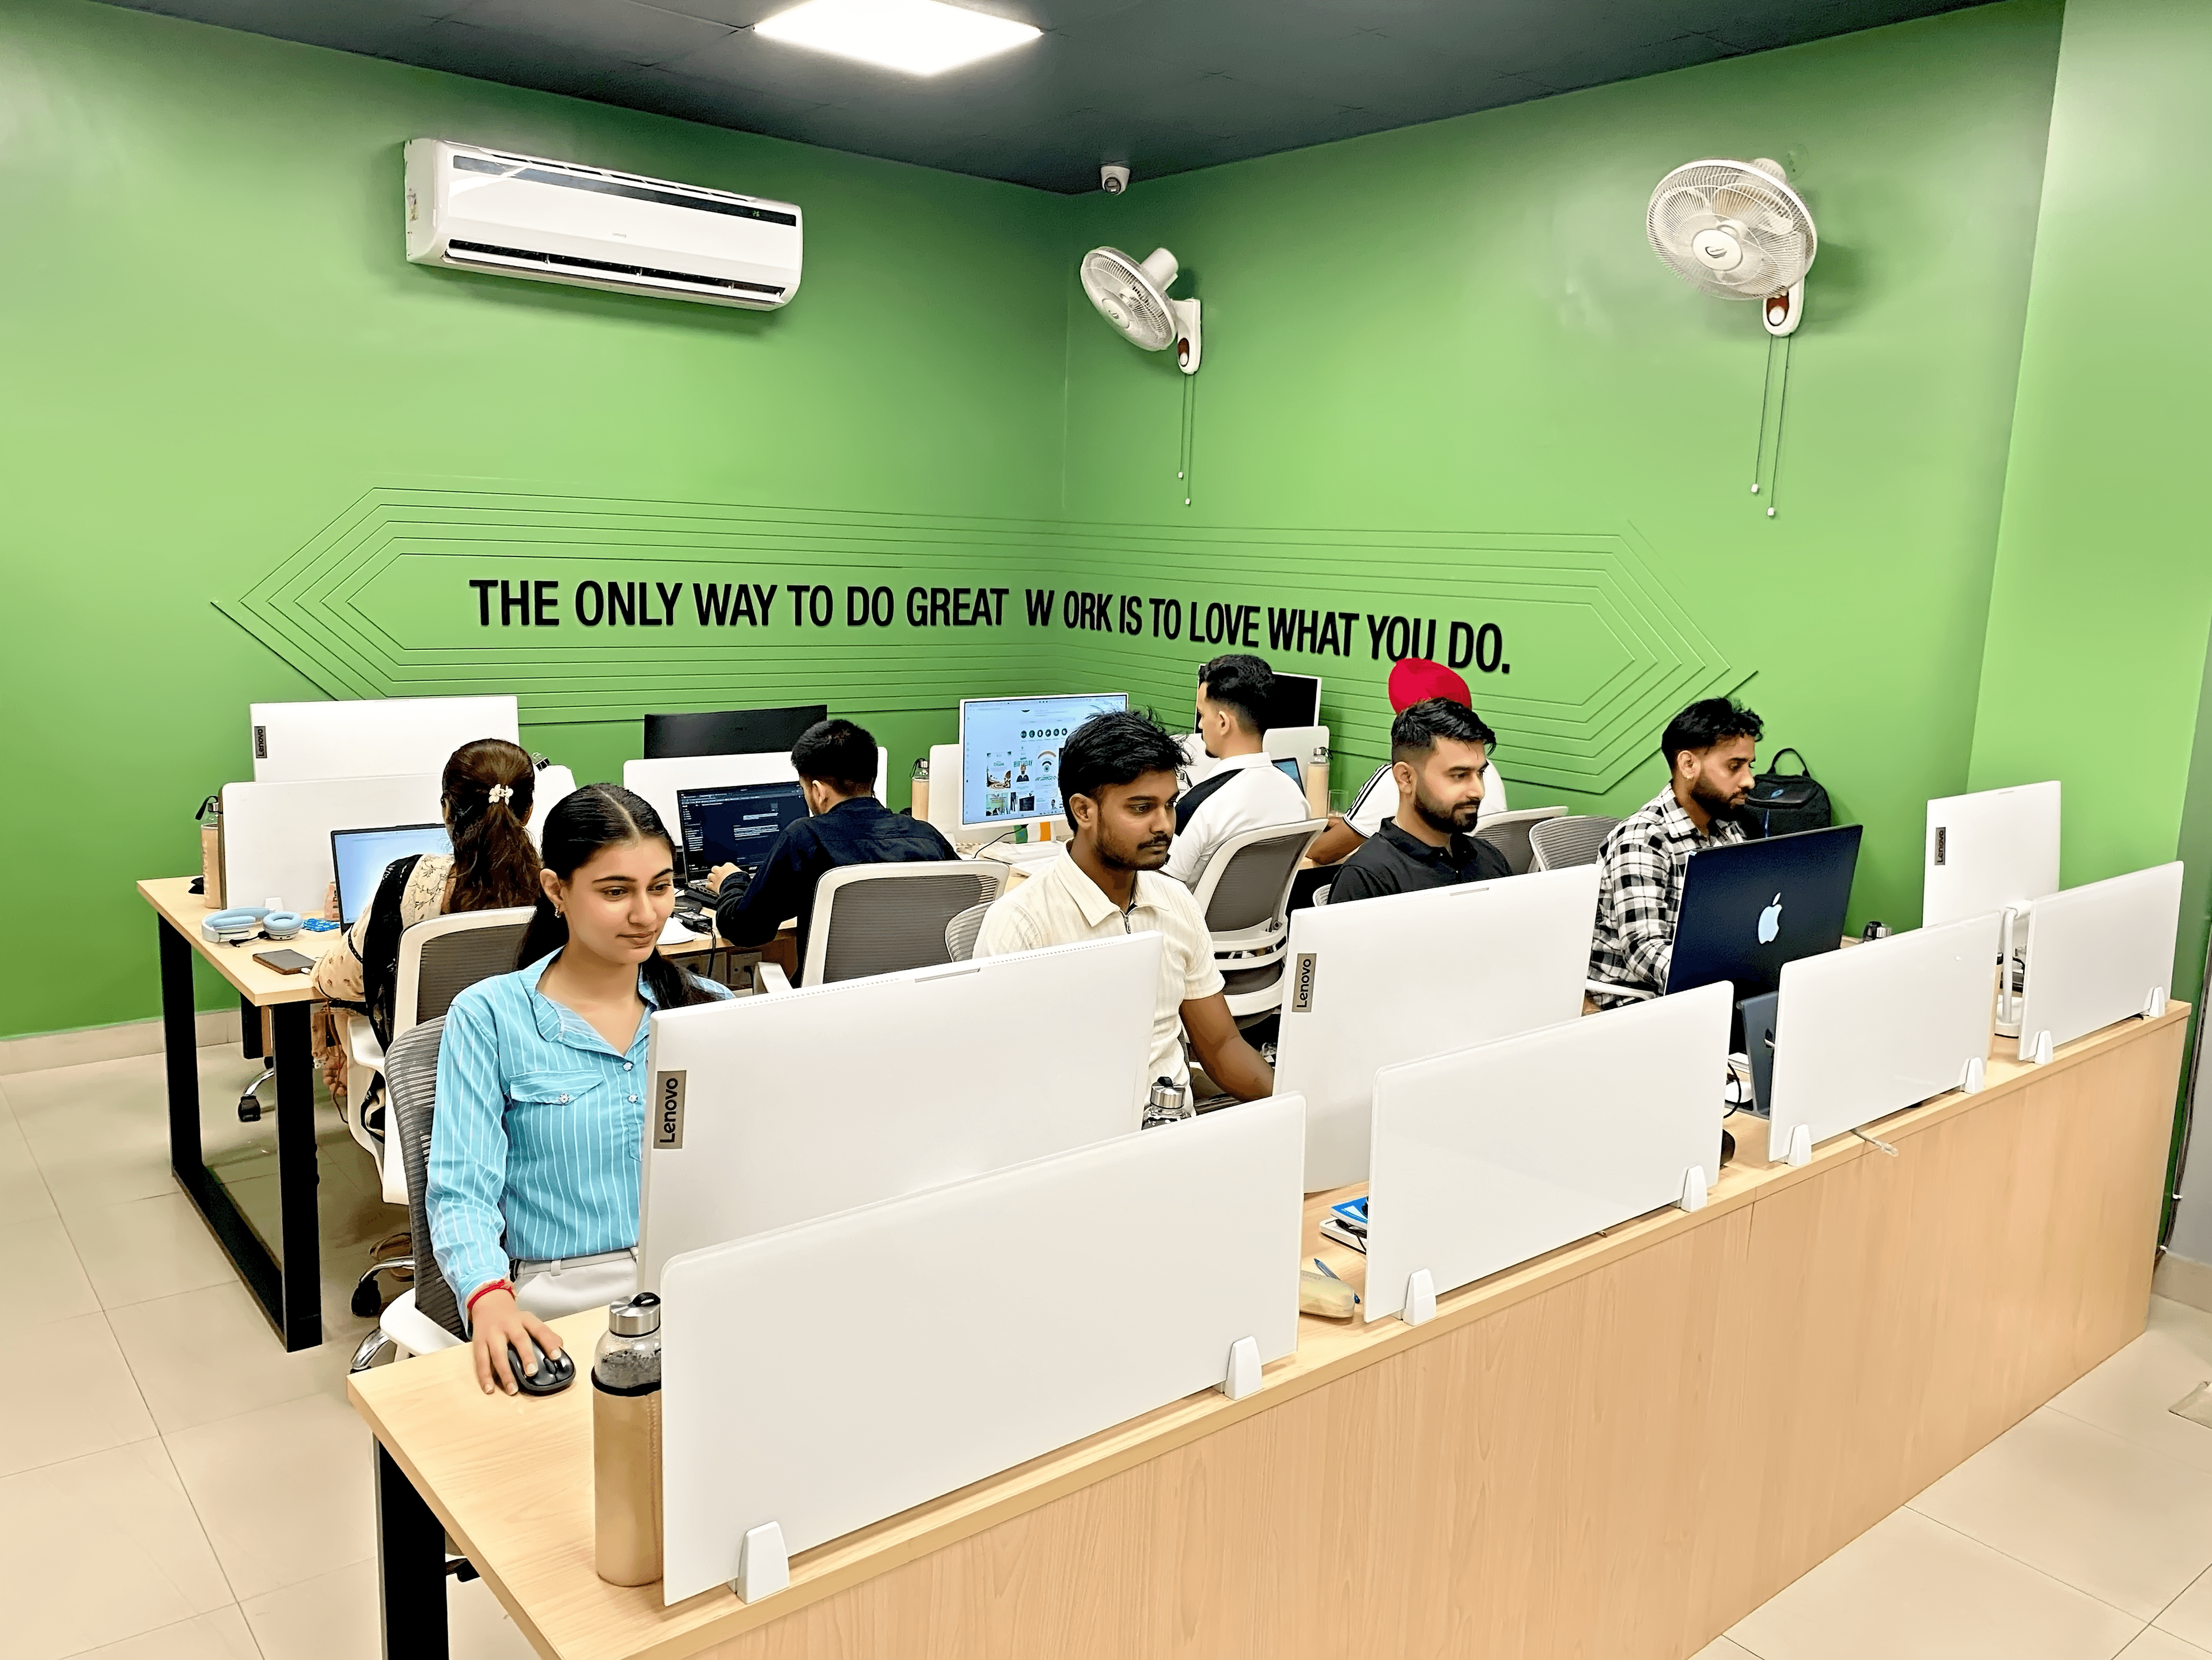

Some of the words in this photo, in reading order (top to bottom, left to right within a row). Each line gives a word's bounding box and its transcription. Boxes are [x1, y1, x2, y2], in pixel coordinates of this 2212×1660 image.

[468, 579, 560, 627] THE
[574, 580, 684, 626] ONLY
[692, 583, 779, 627] WAY
[786, 584, 834, 627] TO
[846, 585, 895, 627] DO
[906, 587, 1010, 627] GREAT
[1119, 595, 1143, 636] IS
[1148, 598, 1182, 640] TO
[1189, 602, 1262, 648] LOVE
[1267, 607, 1359, 657] WHAT
[1366, 614, 1437, 662] YOU
[1447, 621, 1510, 674] DO.
[1296, 958, 1312, 1008] Lenovo
[659, 1077, 679, 1143] Lenovo
